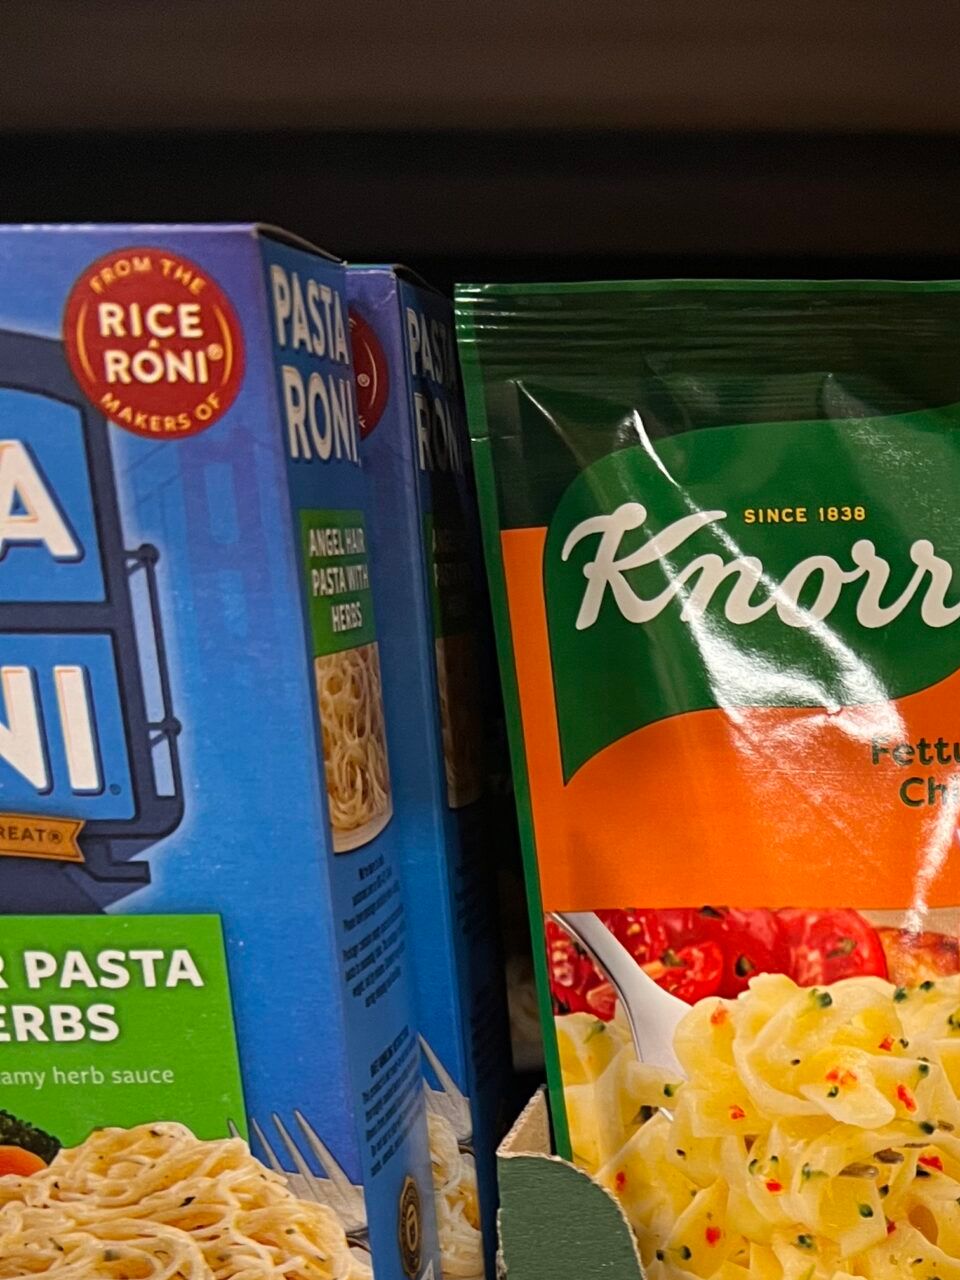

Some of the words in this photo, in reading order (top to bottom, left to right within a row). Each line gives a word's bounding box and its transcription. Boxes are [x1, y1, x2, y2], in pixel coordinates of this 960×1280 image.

[89, 256, 152, 294] FROM
[160, 257, 207, 295] THE
[98, 302, 204, 338] RICE
[270, 263, 350, 366] PASTA
[101, 392, 192, 432] MAKERS
[194, 391, 221, 421] OF
[281, 364, 361, 465] RONI
[743, 507, 808, 524] SINCE
[819, 506, 866, 522] 1838
[308, 527, 345, 558] ANGEL
[346, 526, 366, 554] HAIR
[312, 563, 345, 596] PASTA
[346, 562, 369, 592] WITH
[331, 601, 363, 632] HERBS
[23, 949, 205, 989] PASTA
[53, 1066, 105, 1085] herb
[112, 1068, 175, 1086] sauce
